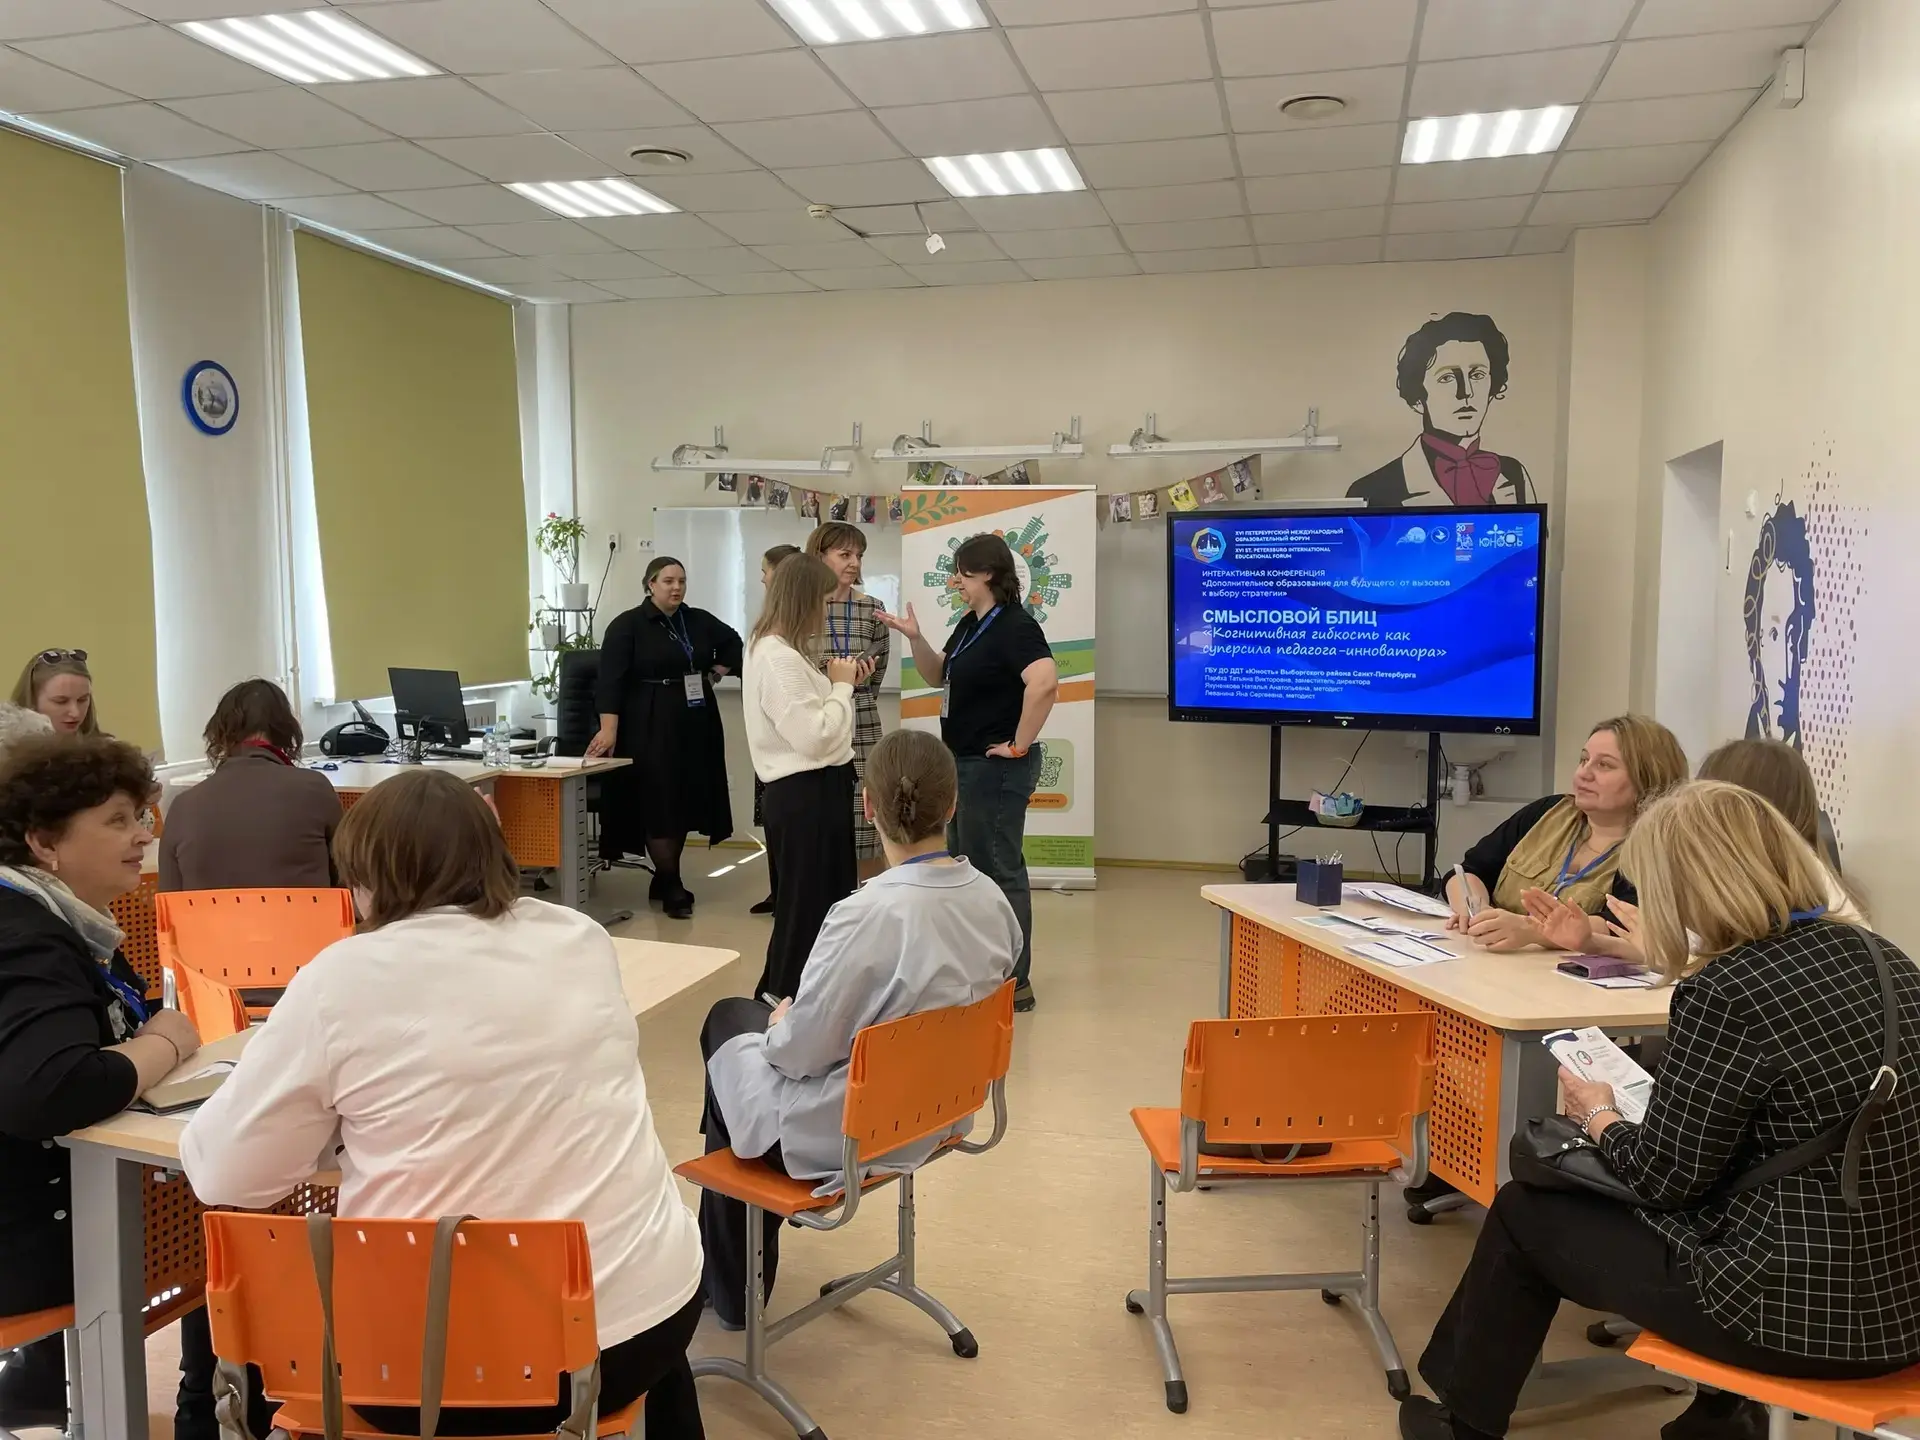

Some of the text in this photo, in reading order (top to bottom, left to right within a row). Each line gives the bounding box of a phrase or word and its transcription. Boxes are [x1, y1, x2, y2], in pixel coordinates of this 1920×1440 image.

[1290, 528, 1344, 536] МЕЖДУНАРОДНЫЙ
[1478, 537, 1524, 549] ЮНОЬ
[1267, 569, 1326, 578] КОНФЕРЕНЦИЯ
[1202, 580, 1274, 588] «Дополнительное
[1276, 579, 1332, 588] образование
[1333, 580, 1349, 588] для
[1208, 589, 1239, 598] выбору
[1241, 590, 1288, 598] стратегии»
[1202, 607, 1378, 628] СМЫСЛОВОЙ БЛИЦ
[1202, 626, 1412, 641] «Когнитивная гибкость как
[1202, 643, 1272, 658] суперсила
[1218, 667, 1229, 675] ДО
[1229, 667, 1244, 675] ДДТ
[1280, 669, 1325, 677] Выборгского
[1326, 669, 1352, 677] района
[1352, 670, 1417, 680] Санкт-Петербурга
[1336, 678, 1371, 686] директора
[1235, 690, 1249, 698] Яна
